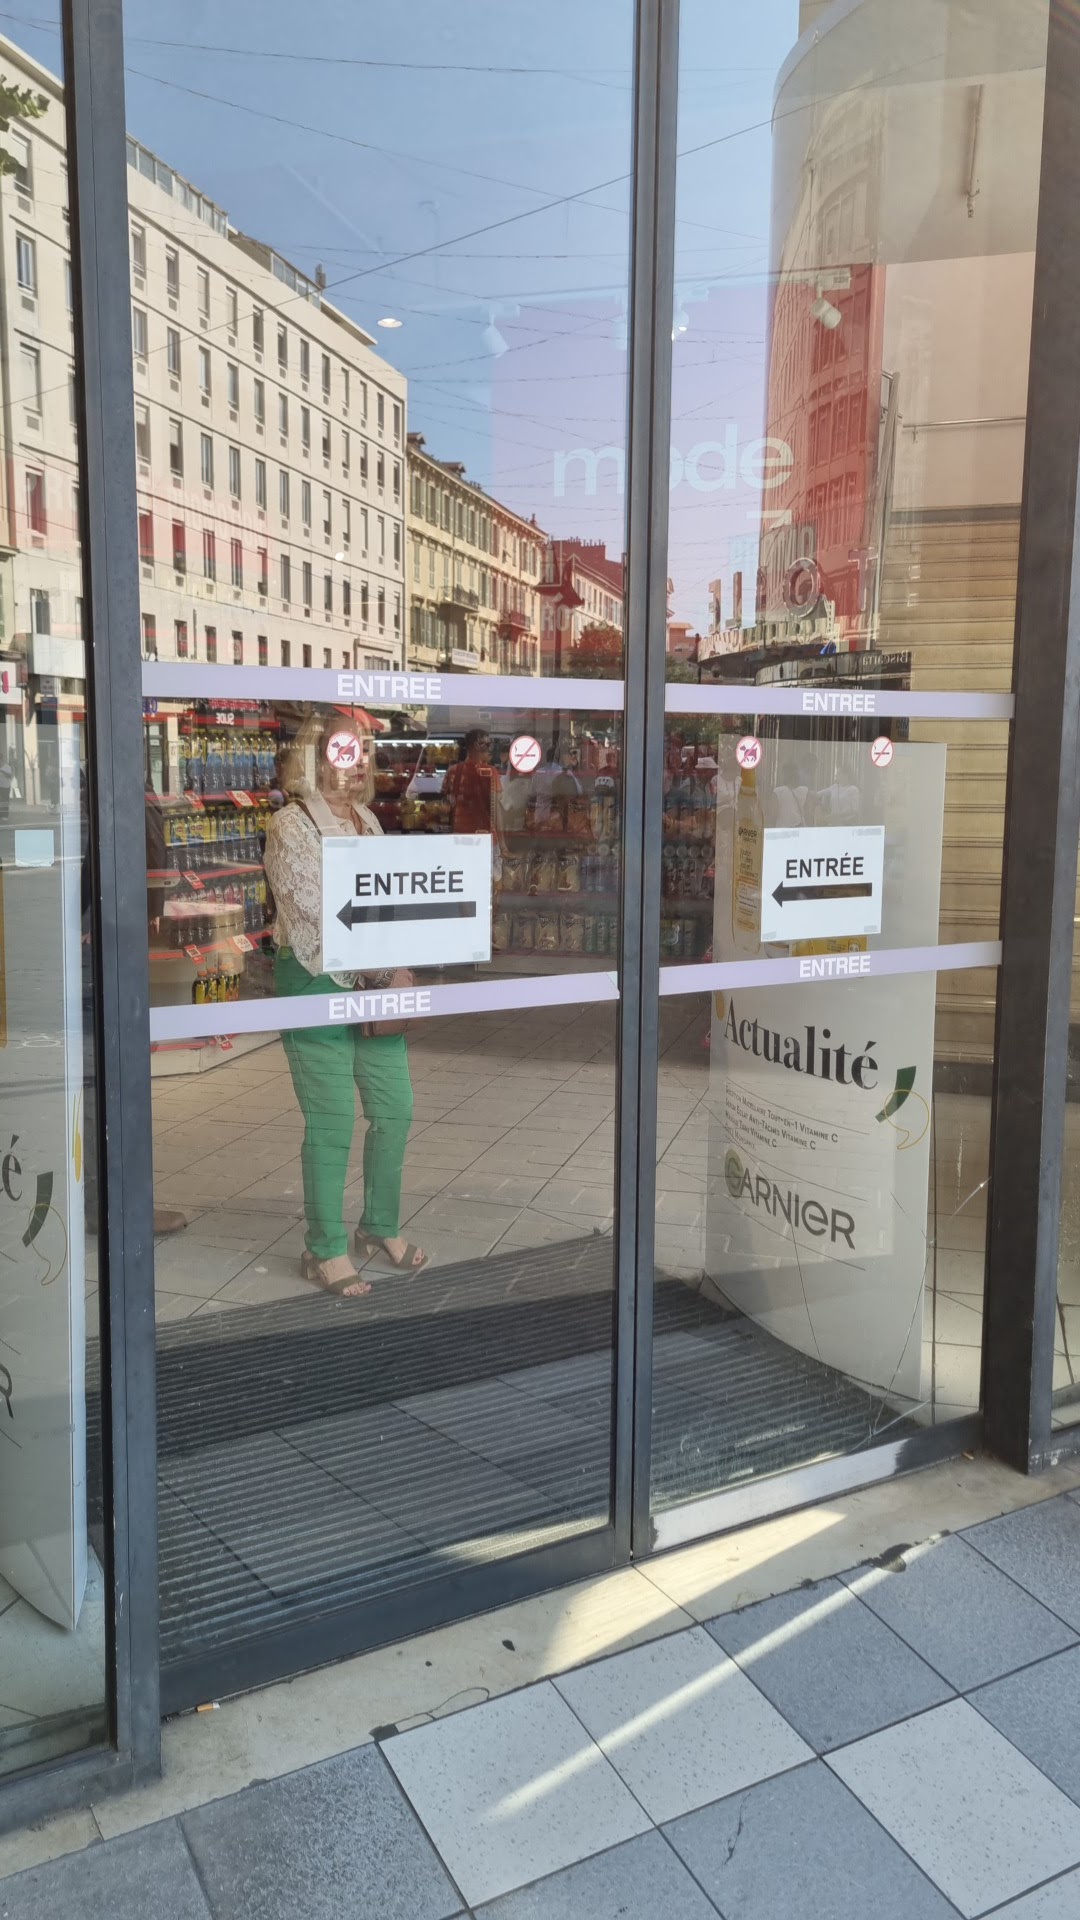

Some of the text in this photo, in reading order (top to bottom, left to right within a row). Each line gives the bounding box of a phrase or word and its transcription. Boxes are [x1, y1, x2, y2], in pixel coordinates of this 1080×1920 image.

[337, 672, 442, 700] ENTREE
[802, 691, 876, 713] ENTREE
[785, 853, 864, 879] ENTRÉE
[355, 866, 464, 897] ENTRÉE
[798, 955, 872, 979] ENTREE
[328, 992, 432, 1020] ENTREE
[724, 997, 879, 1091] Actualité
[771, 1138, 777, 1148] C
[781, 1129, 808, 1147] VITAMINE
[810, 1140, 816, 1150] C
[800, 1122, 829, 1140] VITAMINE
[831, 1133, 838, 1143] C
[724, 1149, 856, 1250] GARNIER
